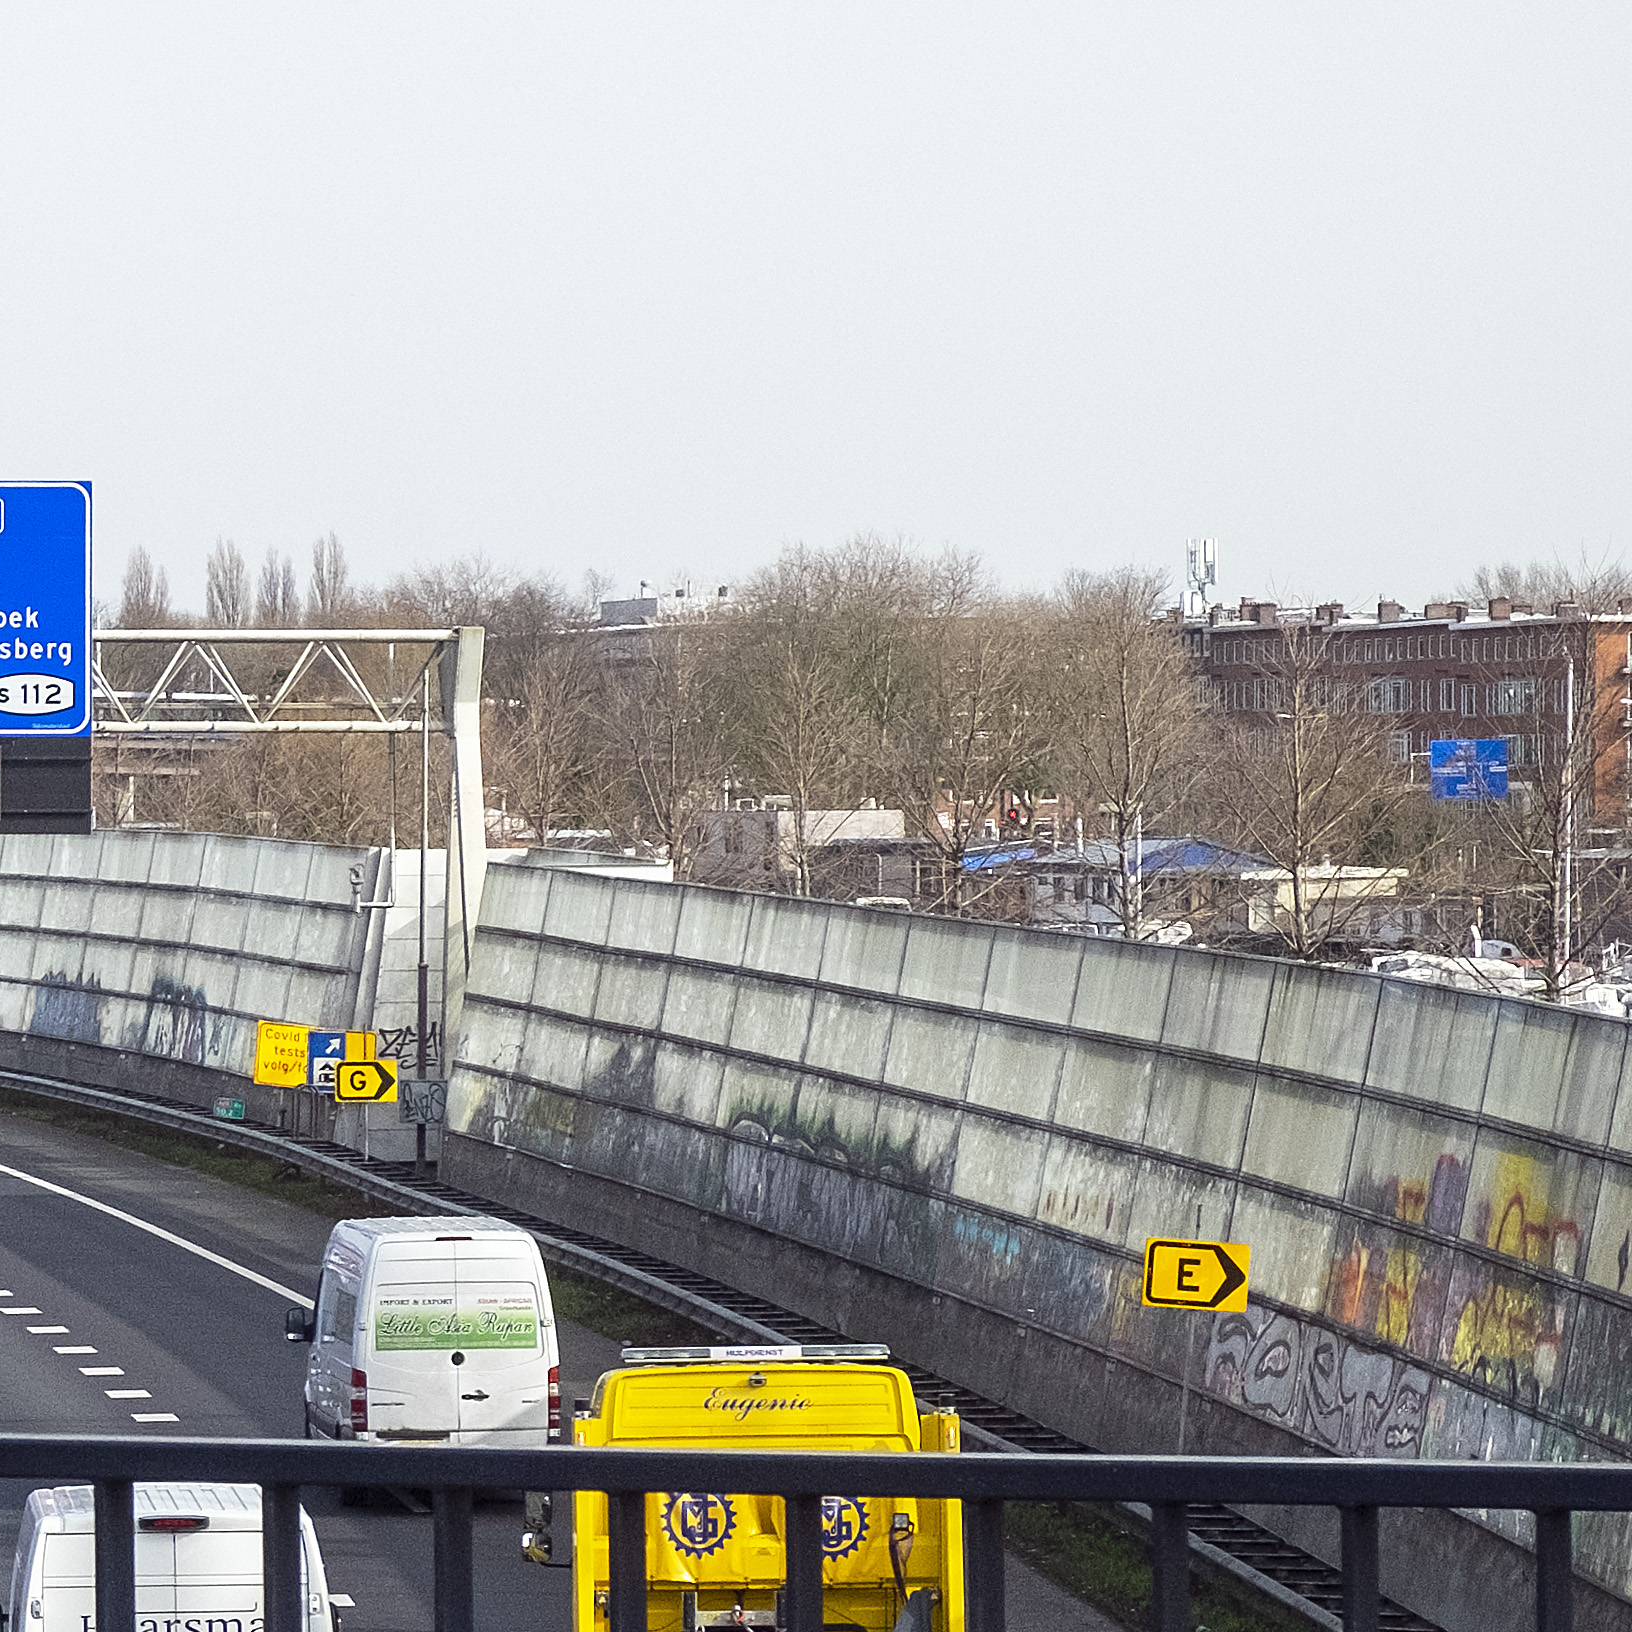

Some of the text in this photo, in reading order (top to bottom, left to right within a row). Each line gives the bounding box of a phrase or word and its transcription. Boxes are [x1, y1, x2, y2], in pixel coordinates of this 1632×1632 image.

[20, 684, 62, 704] 112
[265, 1028, 300, 1043] Covid
[274, 1046, 306, 1058] tests
[349, 1069, 367, 1091] G
[1177, 1257, 1202, 1293] E
[378, 1312, 423, 1336] Little
